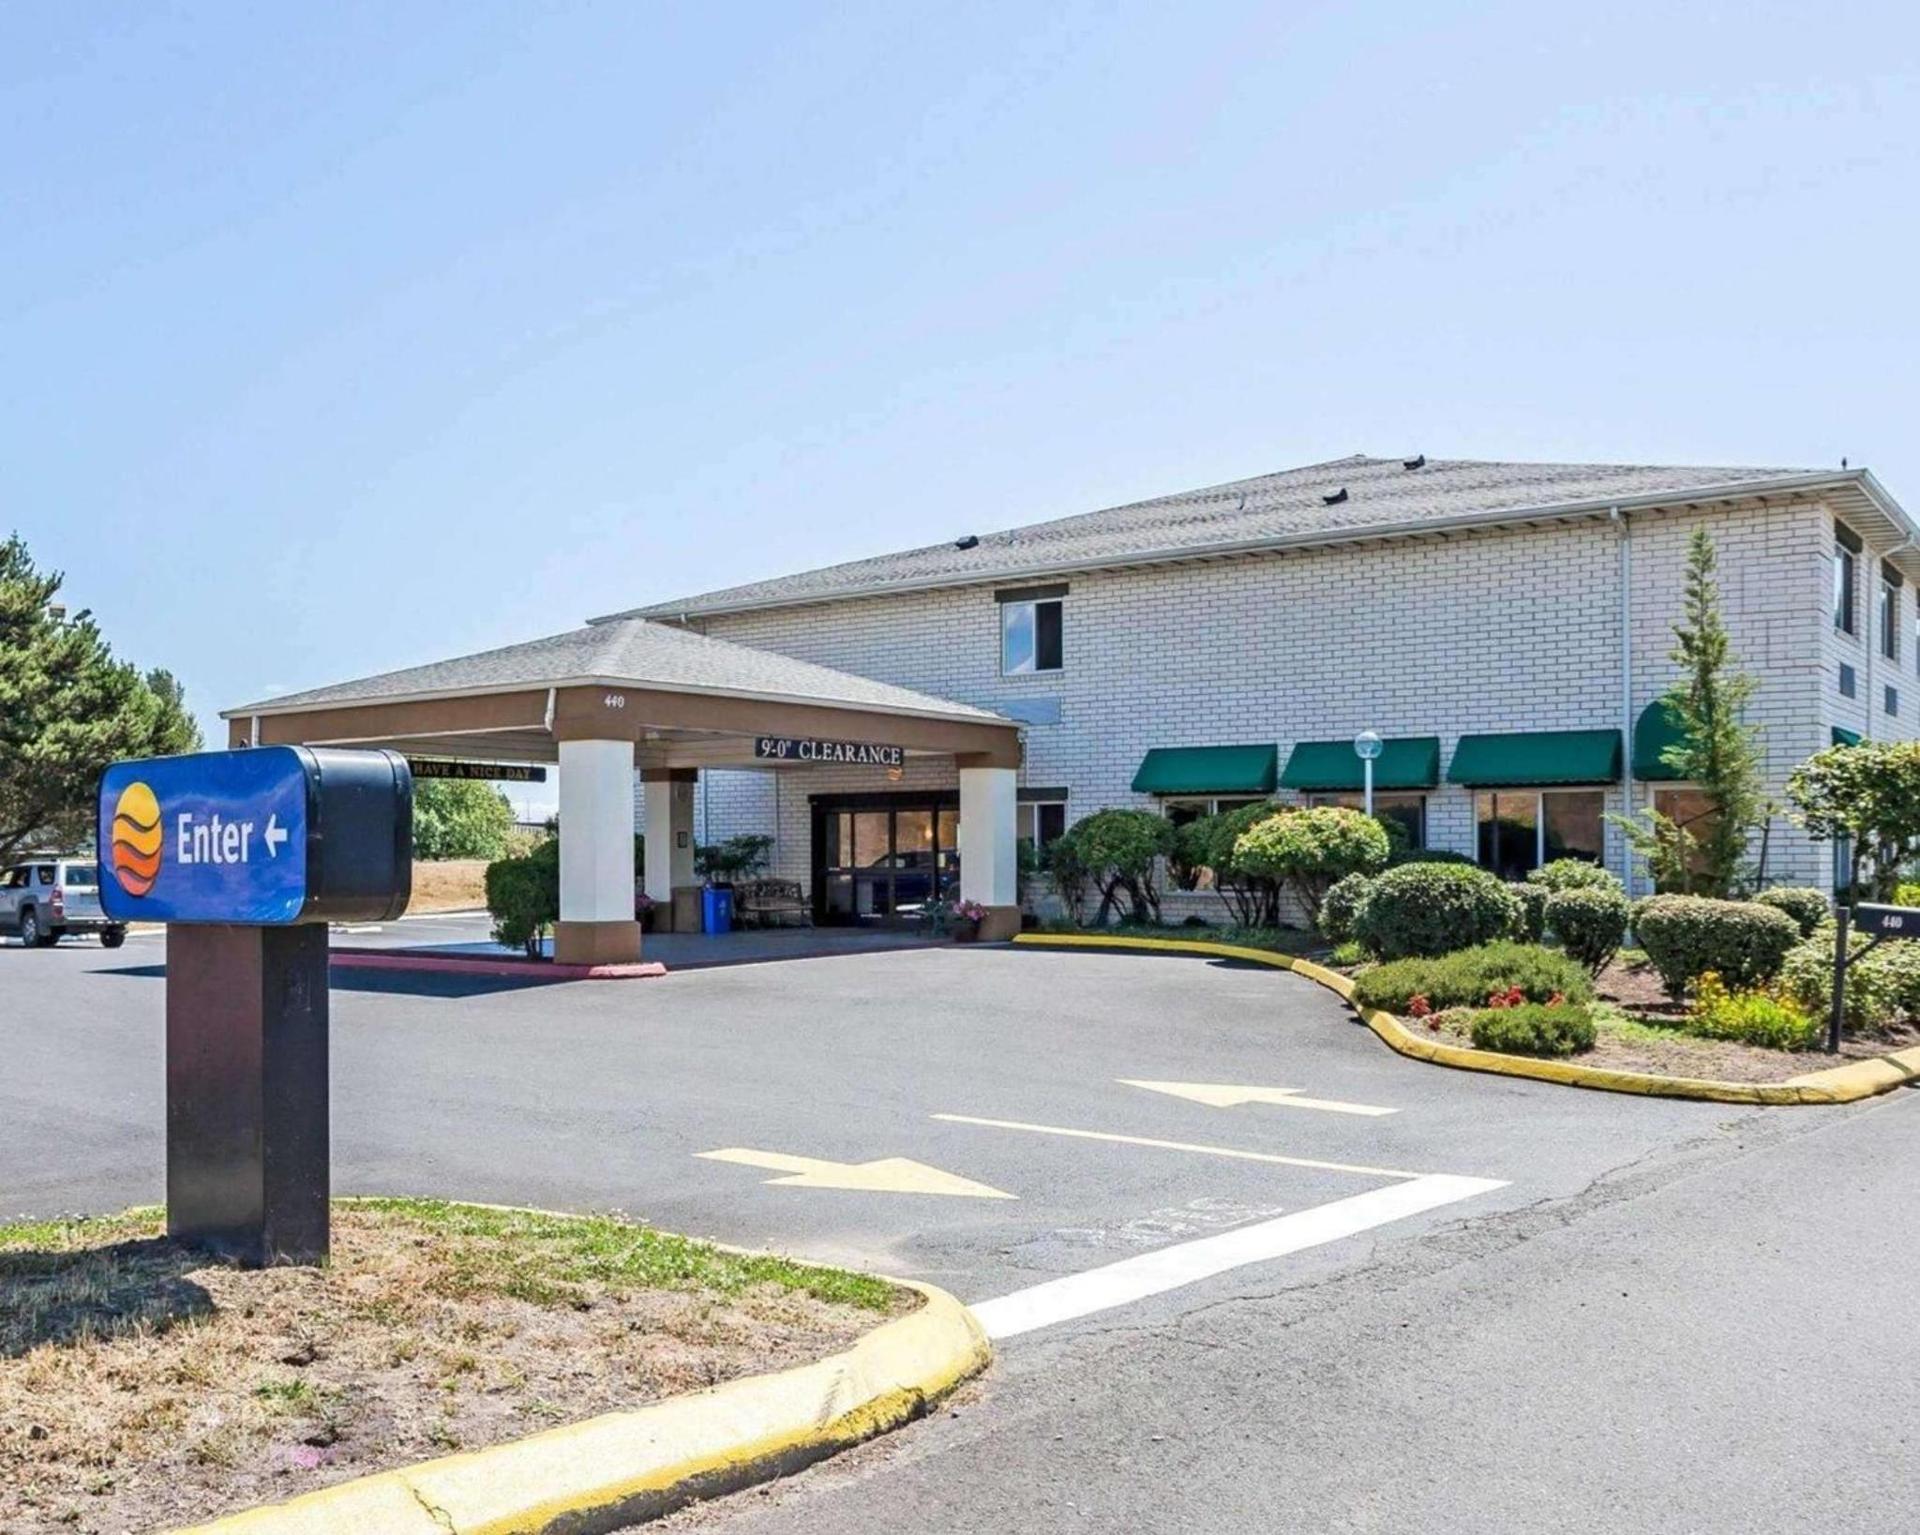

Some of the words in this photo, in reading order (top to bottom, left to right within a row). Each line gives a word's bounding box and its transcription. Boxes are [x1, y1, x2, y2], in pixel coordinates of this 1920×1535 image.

[604, 694, 625, 708] 440
[799, 741, 900, 765] CLEARANCE
[470, 766, 501, 778] NICE
[506, 767, 531, 779] DAY
[177, 813, 253, 864] Enter
[1882, 914, 1903, 929] 440
